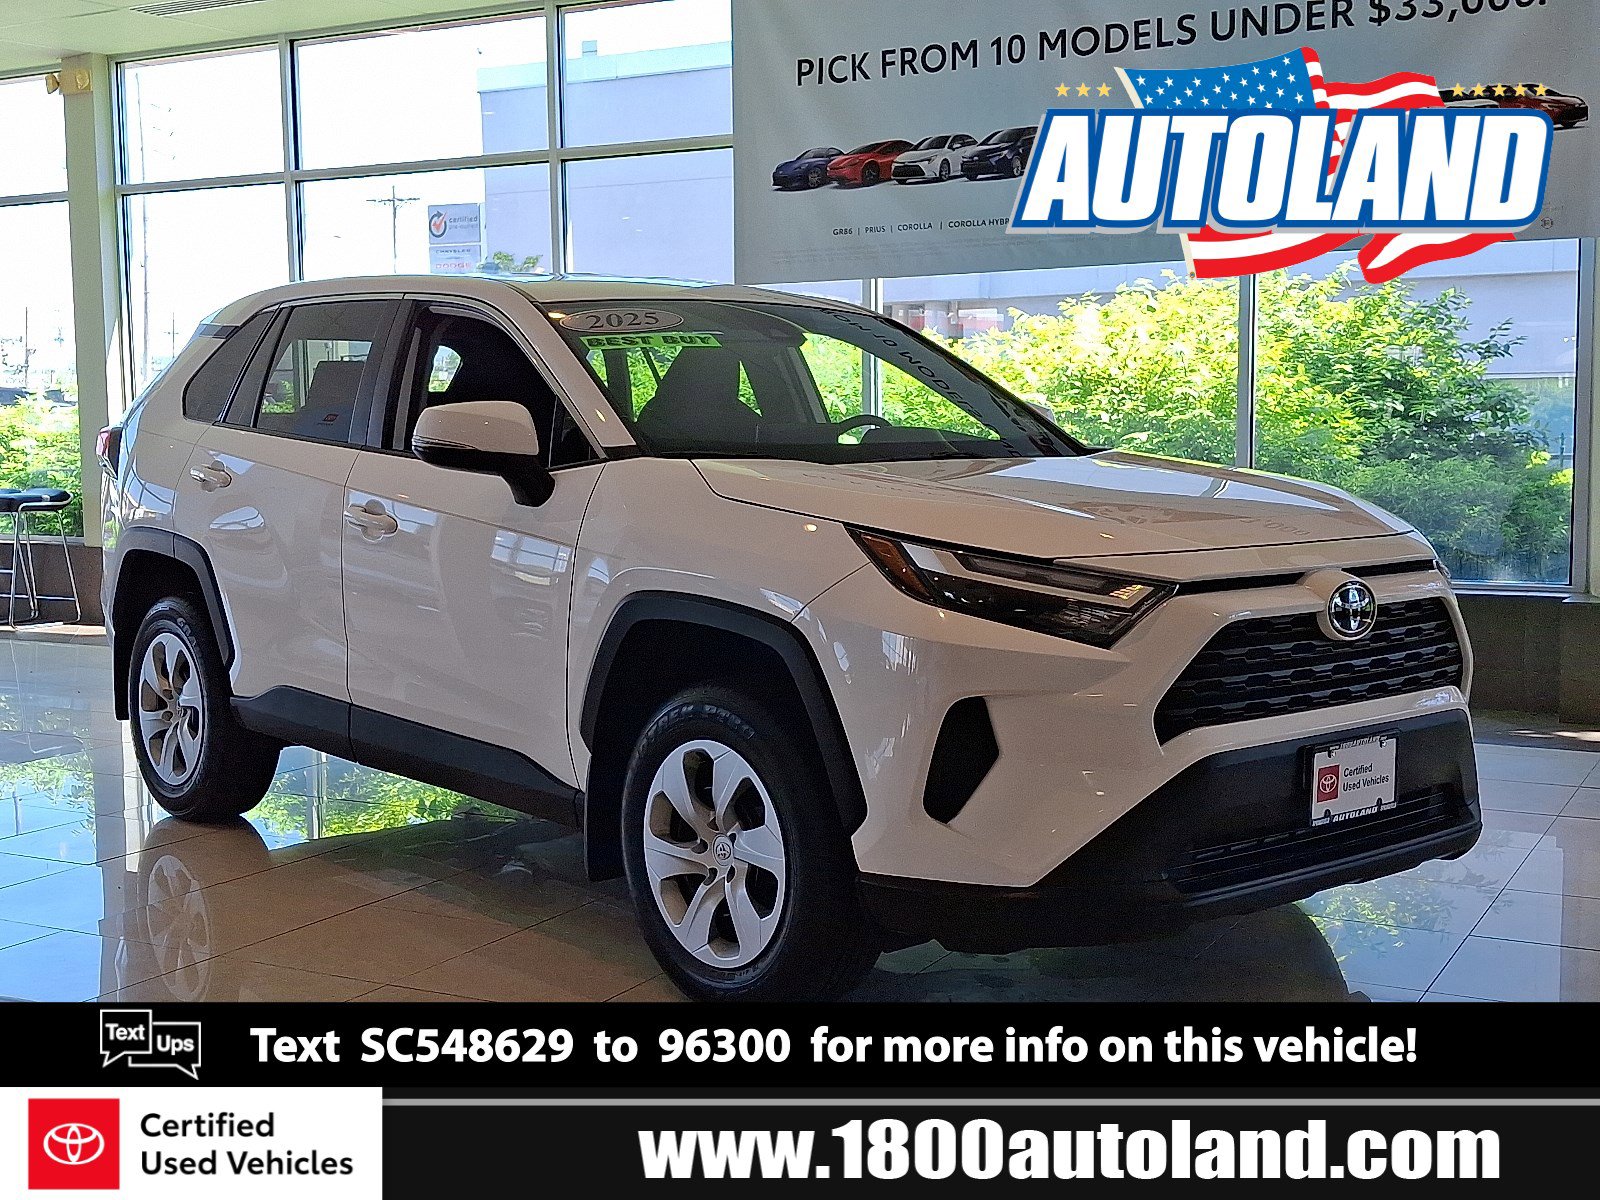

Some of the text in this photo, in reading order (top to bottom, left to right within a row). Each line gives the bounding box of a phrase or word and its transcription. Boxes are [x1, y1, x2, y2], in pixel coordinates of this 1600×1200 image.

[797, 52, 871, 87] PICK
[881, 40, 978, 78] FROM
[990, 34, 1026, 66] 10
[1038, 14, 1197, 61] MODELS
[1211, 0, 1355, 42] UNDER
[832, 217, 1010, 236] GR86 PRIUS COROLLA COROLLA HYBR
[585, 312, 660, 329] 2025
[586, 335, 712, 347] BEST BUY
[1343, 763, 1373, 778] Certified
[1342, 774, 1390, 792] Used Vehicles
[1332, 806, 1378, 823] AUTOLAND
